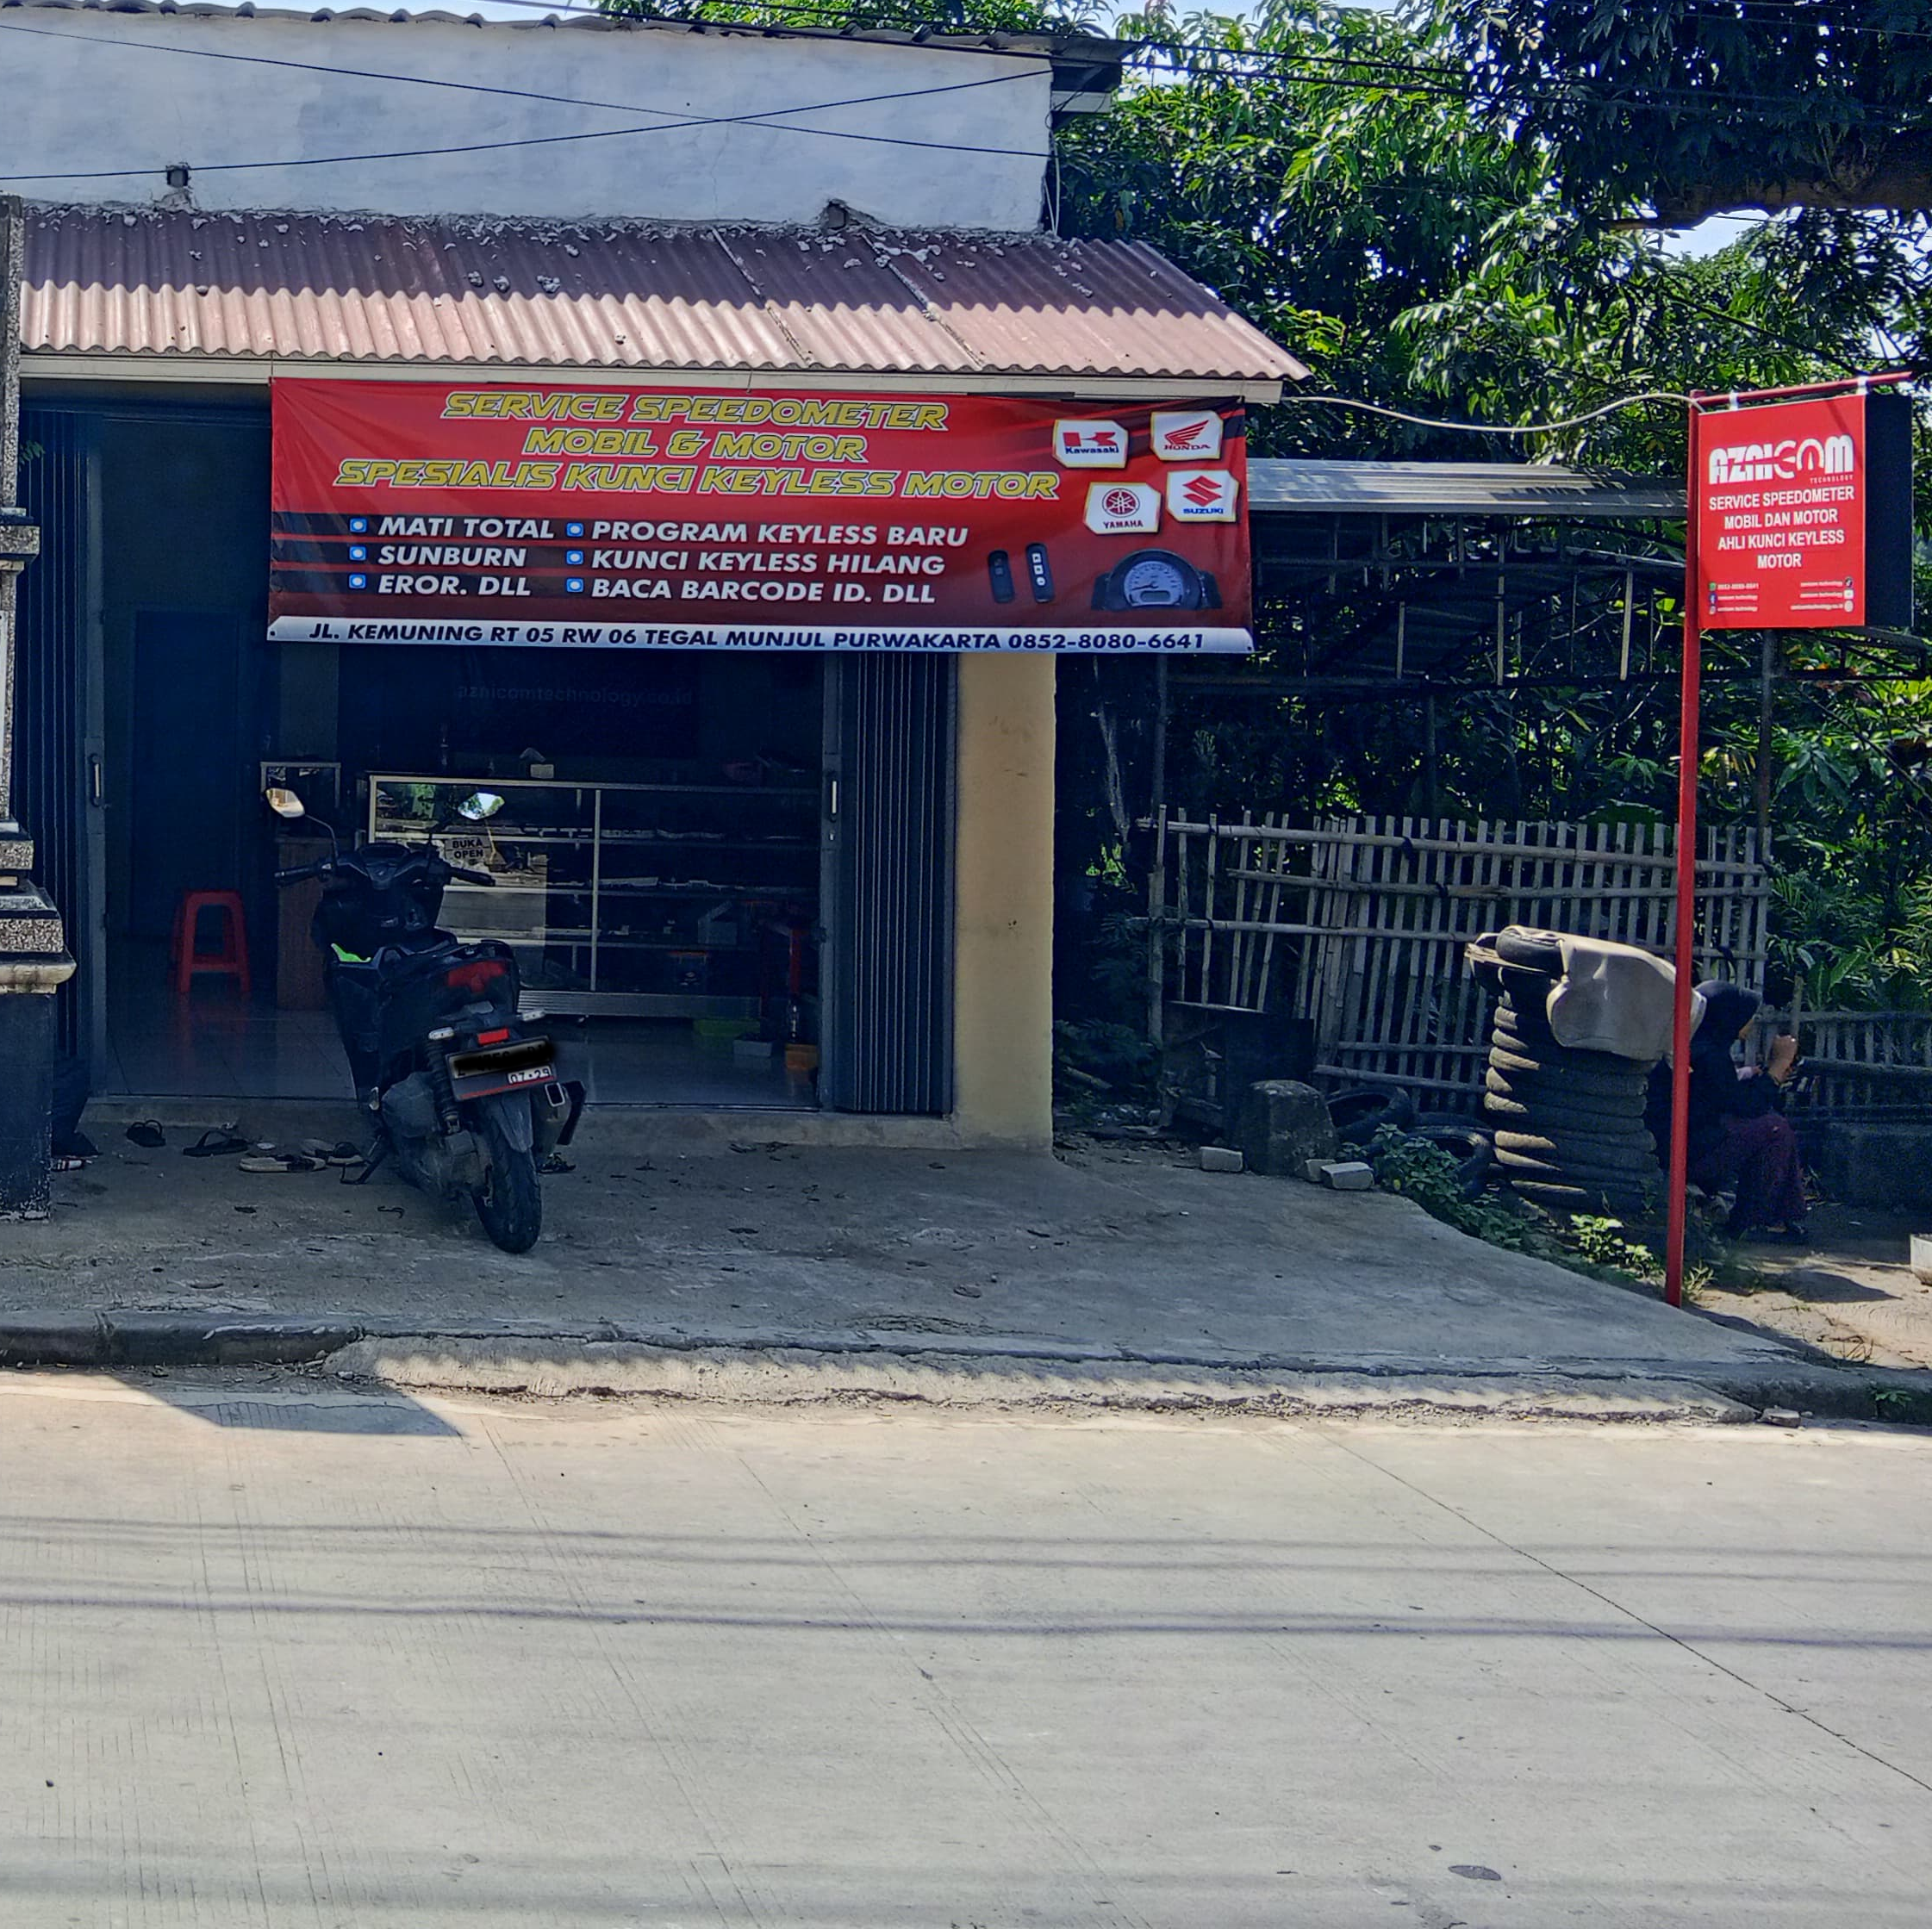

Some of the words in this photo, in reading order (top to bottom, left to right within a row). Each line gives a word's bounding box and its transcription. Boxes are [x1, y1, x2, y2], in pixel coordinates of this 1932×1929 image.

[440, 391, 625, 421] SERVICE
[628, 395, 948, 431] SPEEDOMETER
[522, 427, 657, 457] MOBIL
[667, 430, 708, 458] &
[710, 432, 868, 463] MOTOR
[1065, 445, 1119, 455] Kawasaki
[1163, 443, 1211, 451] HONDA
[333, 459, 561, 490] SPESIALIS
[562, 464, 693, 494] KUNCI
[697, 466, 899, 497] KEYLESS
[901, 470, 1060, 500] MOTOR
[1810, 475, 1854, 484] TECHNOLOGY
[1709, 494, 1760, 511] SERVICE
[1763, 486, 1854, 507] SPEEDOMETER
[377, 518, 454, 538] MATI
[463, 519, 554, 538] TOTAL
[1103, 520, 1144, 529] YAMAHA
[1724, 514, 1762, 530] MOBIL
[1765, 512, 1792, 527] DAN
[1794, 508, 1838, 526] MOTOR
[591, 521, 747, 543] PROGRAM
[757, 525, 876, 545] KEYLESS
[888, 527, 968, 546] BARU
[1717, 536, 1745, 551] AHLI
[1748, 533, 1785, 549] KUNCI
[1788, 530, 1845, 546] KEYLESS
[377, 546, 527, 568] SUNBURN
[591, 550, 687, 570] KUNCI
[698, 552, 818, 573] KEYLESS
[827, 555, 945, 575] HILANG
[1757, 553, 1802, 569] MOTOR
[377, 575, 467, 595] EROR.
[477, 577, 531, 596] DLL
[591, 578, 671, 599] BACA
[681, 581, 823, 601] BARCODE
[833, 582, 871, 603] ID.
[882, 583, 936, 603] DLL
[308, 623, 340, 639] JL.
[347, 625, 483, 642] KEMUNING
[490, 627, 519, 643] RT
[526, 627, 555, 644] 05
[561, 628, 602, 644] RW
[608, 629, 637, 644] 06
[645, 630, 718, 645] TEGAL
[726, 631, 825, 648] MUNJUL
[833, 632, 1000, 650] PURWAKARTA
[1007, 633, 1205, 650] 0852-8080-6641
[452, 839, 483, 849] BUKA
[453, 849, 483, 859] OPEN
